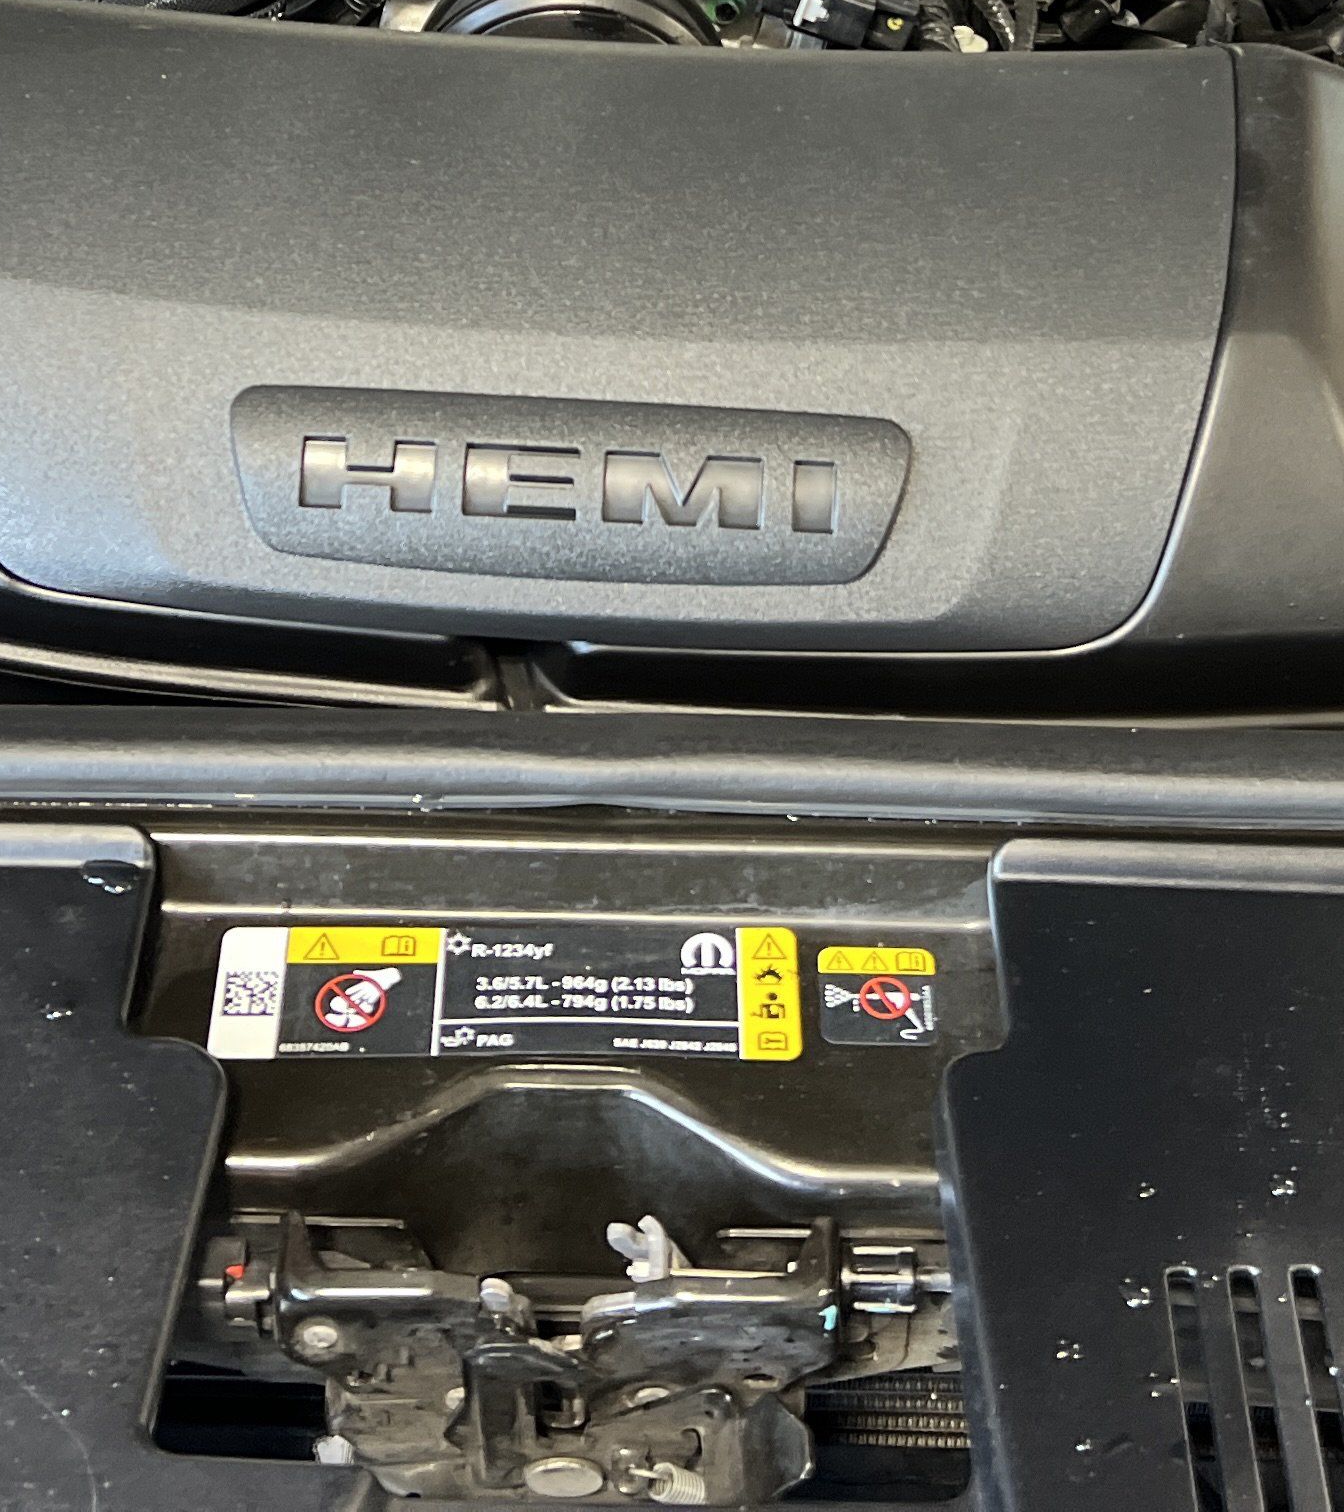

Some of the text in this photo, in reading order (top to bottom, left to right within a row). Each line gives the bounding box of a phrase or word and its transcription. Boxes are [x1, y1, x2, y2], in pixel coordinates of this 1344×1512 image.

[299, 435, 838, 534] HEMI
[471, 943, 554, 960] R-1234yf
[476, 976, 549, 991] 3.6/5.7L
[611, 976, 656, 994] (2.13
[658, 977, 694, 995] lbs)
[474, 995, 549, 1010] 6.2/6.4L
[561, 995, 608, 1012] 794g
[611, 995, 656, 1012] (1.75
[658, 996, 694, 1014] lbs)
[476, 1033, 514, 1048] PAG
